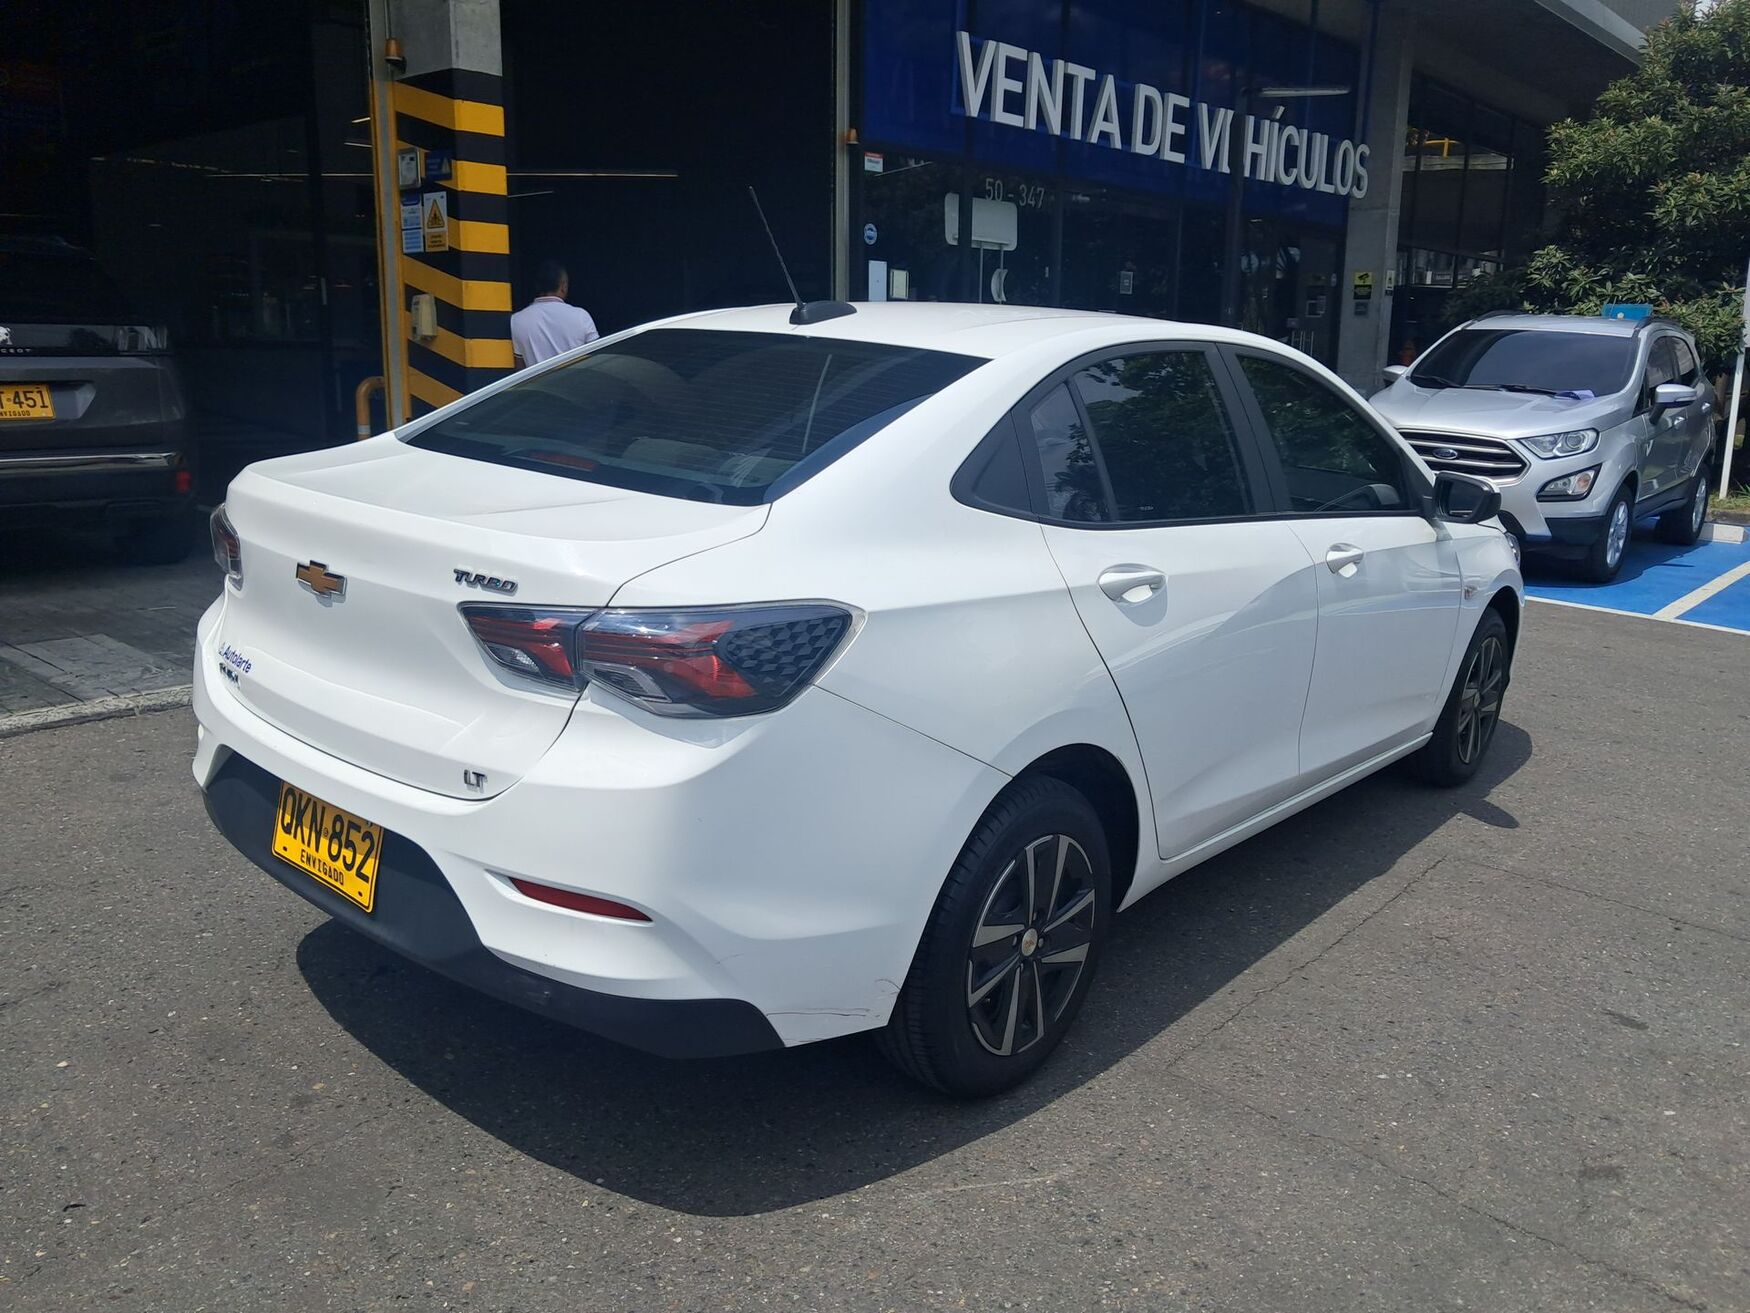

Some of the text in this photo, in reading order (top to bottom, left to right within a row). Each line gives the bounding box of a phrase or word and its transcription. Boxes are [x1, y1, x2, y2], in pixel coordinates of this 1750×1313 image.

[956, 31, 1122, 149] VENTA
[1131, 83, 1190, 164] DE
[985, 178, 1003, 201] 50
[1019, 184, 1045, 208] 347
[13, 390, 49, 409] 451
[453, 568, 518, 595] TURBO
[463, 769, 486, 788] LT
[280, 787, 375, 884] QKN 852
[300, 848, 345, 886] ENVIGADO
